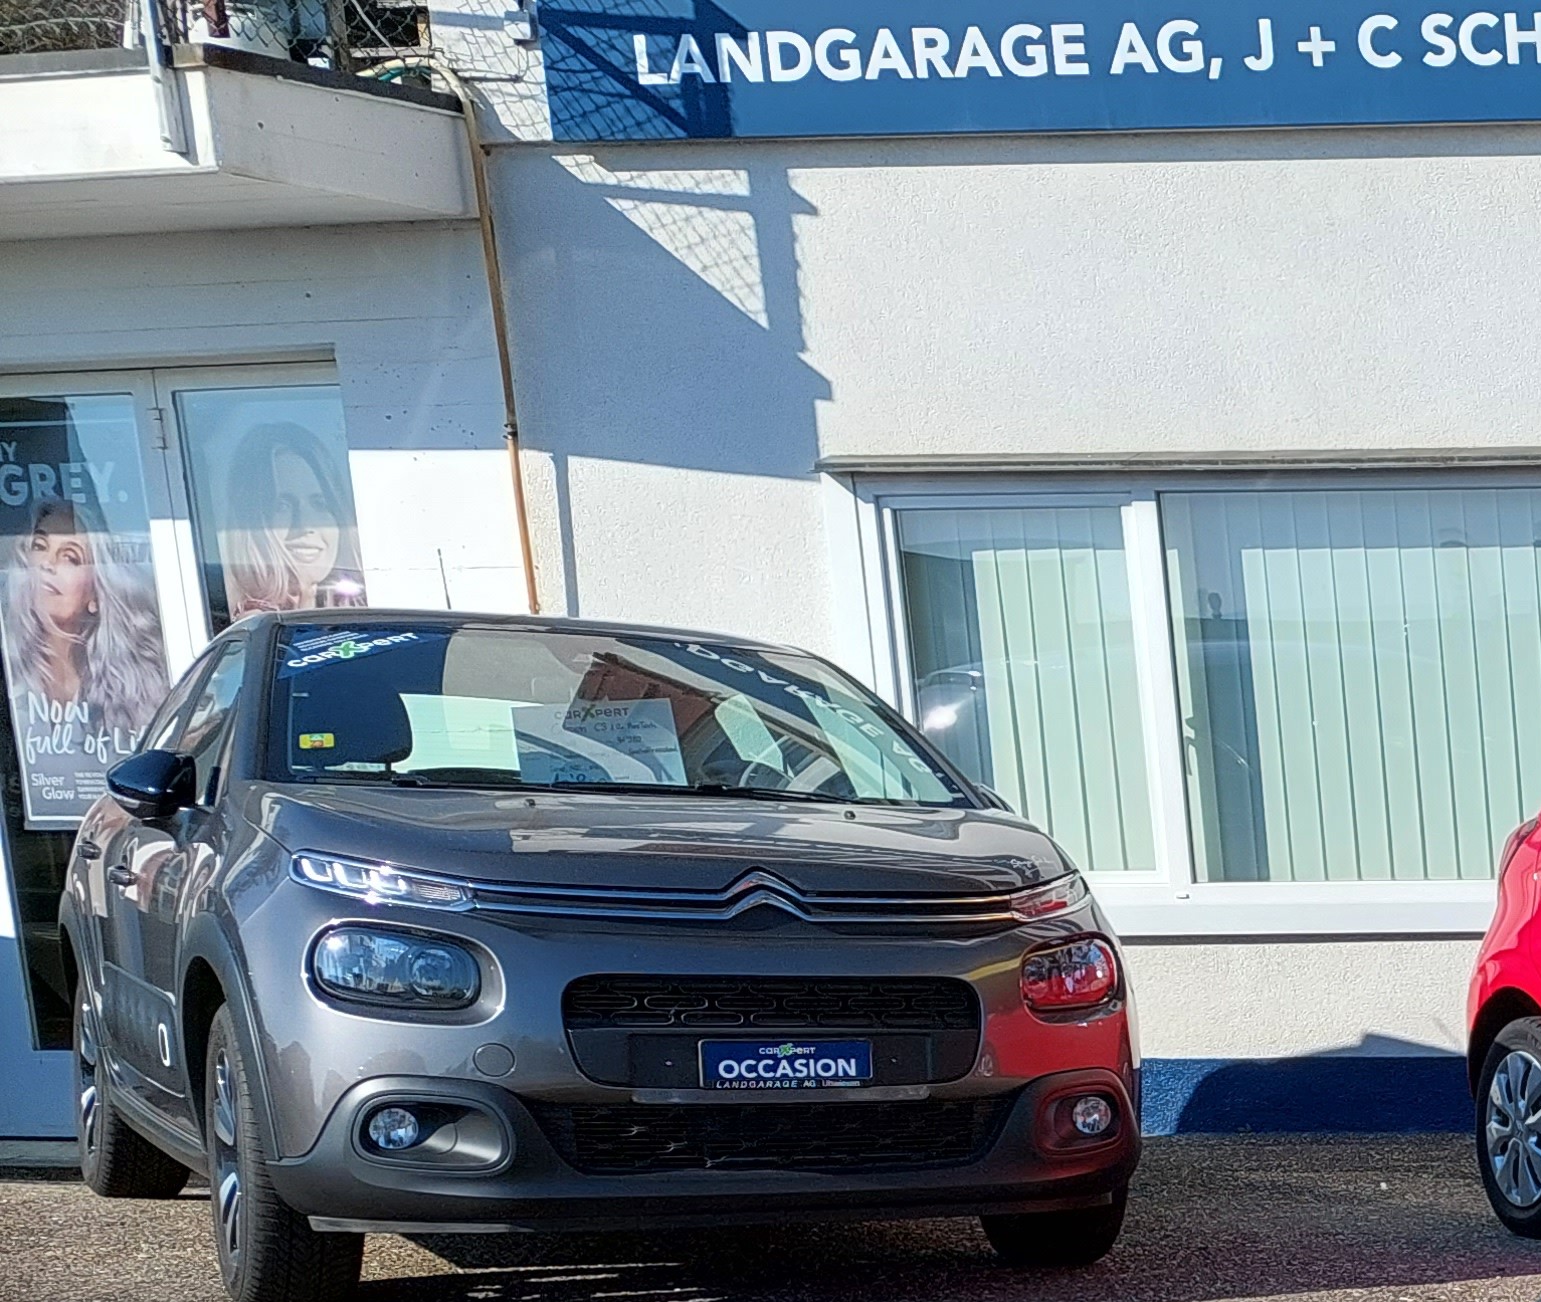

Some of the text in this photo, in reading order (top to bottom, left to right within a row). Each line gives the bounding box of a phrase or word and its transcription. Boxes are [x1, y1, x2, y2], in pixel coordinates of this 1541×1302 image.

[633, 23, 1090, 85] LANDGARAGE
[1109, 19, 1223, 80] AG,
[1243, 18, 1275, 72] J
[1297, 26, 1336, 67] +
[1357, 14, 1402, 68] C
[0, 461, 128, 506] GREY.
[28, 690, 89, 724] Now
[25, 723, 76, 764] full
[83, 727, 112, 764] of
[31, 773, 65, 787] Silver
[42, 787, 76, 800] Glow
[717, 1058, 857, 1079] OCCASION
[716, 1080, 798, 1089] LANDGARAGE
